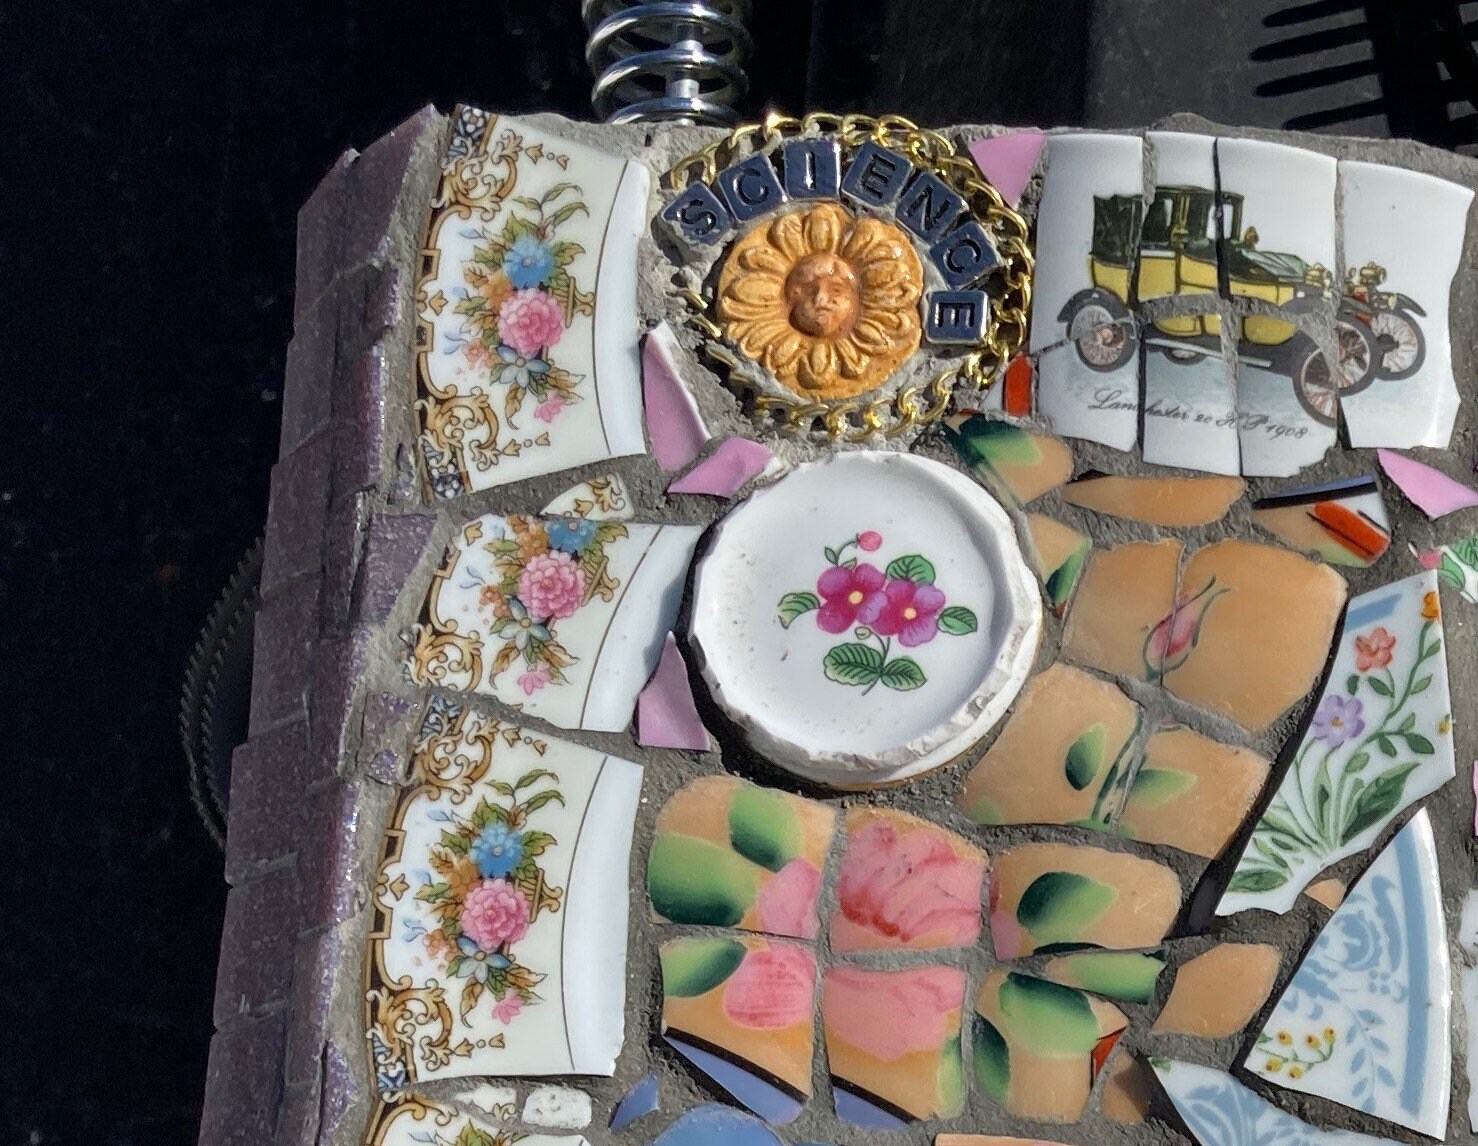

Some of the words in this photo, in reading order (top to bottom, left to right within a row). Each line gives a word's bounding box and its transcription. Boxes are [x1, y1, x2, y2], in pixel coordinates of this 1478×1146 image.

[675, 146, 982, 329] SCIENCE
[1087, 387, 1191, 420] Lanhester
[1265, 424, 1309, 441] 1908
